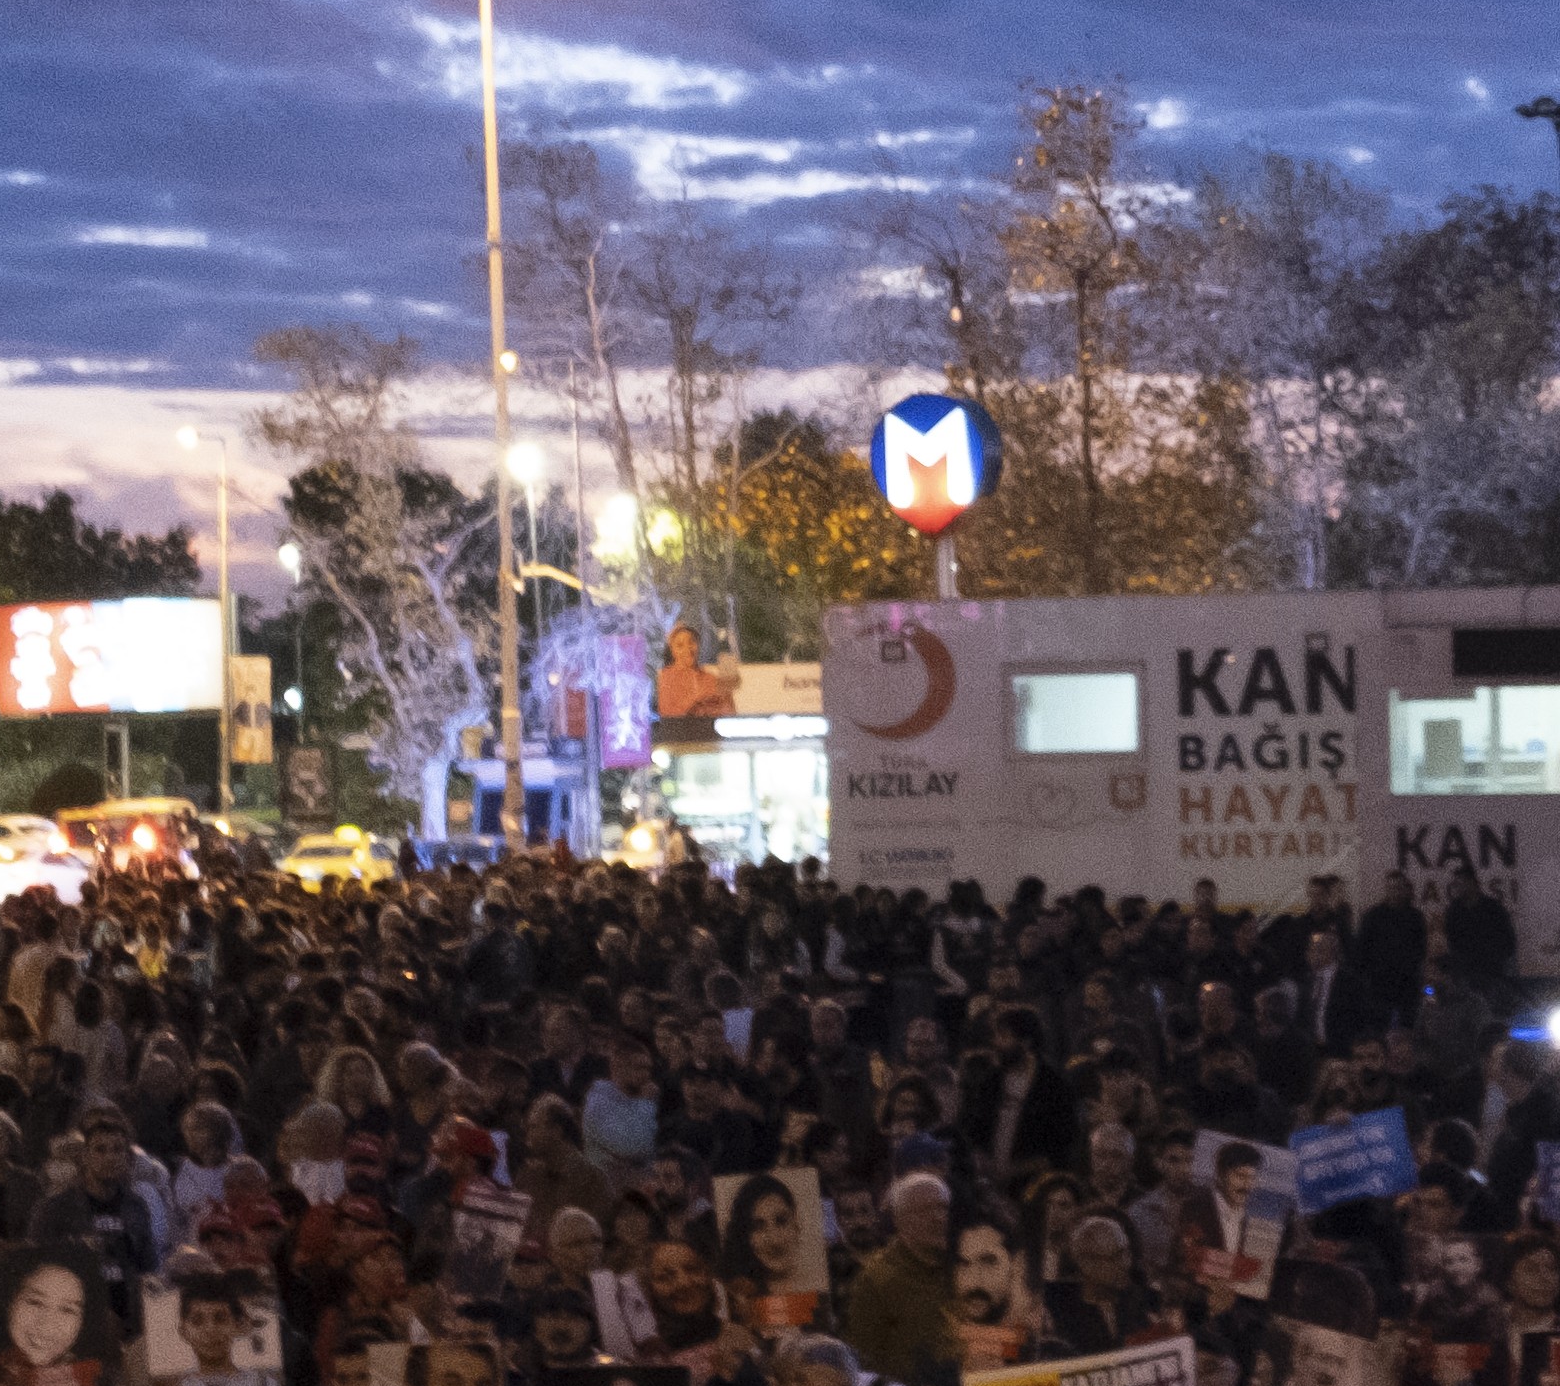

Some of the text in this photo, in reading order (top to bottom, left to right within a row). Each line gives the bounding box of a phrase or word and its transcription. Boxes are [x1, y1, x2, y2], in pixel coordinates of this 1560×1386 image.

[884, 406, 977, 510] M
[1178, 646, 1356, 716] KAN
[848, 771, 959, 799] KIZILAY
[1179, 783, 1358, 824] HAYAT
[1396, 824, 1517, 869] KAN
